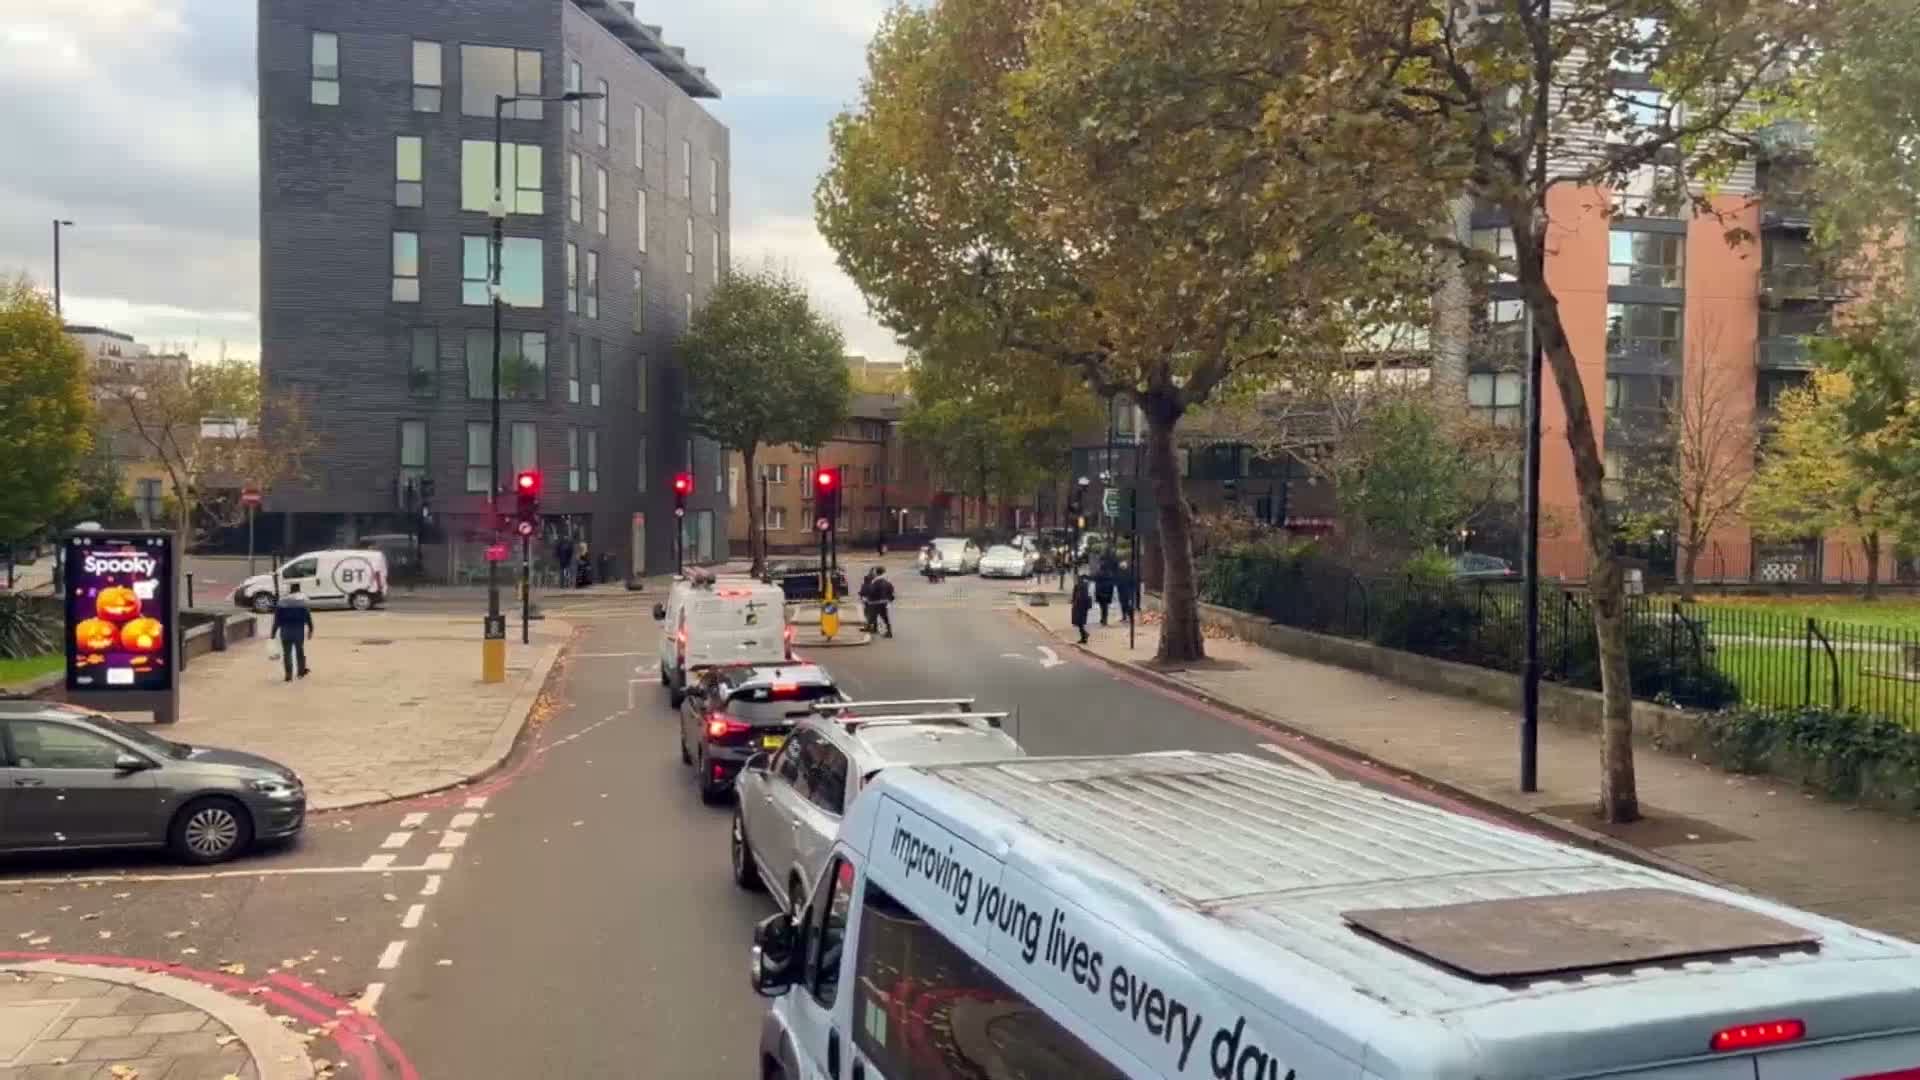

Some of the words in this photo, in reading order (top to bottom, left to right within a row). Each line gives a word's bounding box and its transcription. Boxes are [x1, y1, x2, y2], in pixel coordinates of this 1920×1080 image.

[84, 556, 156, 576] Spooky
[343, 568, 365, 582] BT
[890, 815, 973, 915] improving
[973, 877, 1043, 964] young
[1045, 908, 1103, 994] lives
[1109, 965, 1202, 1072] every
